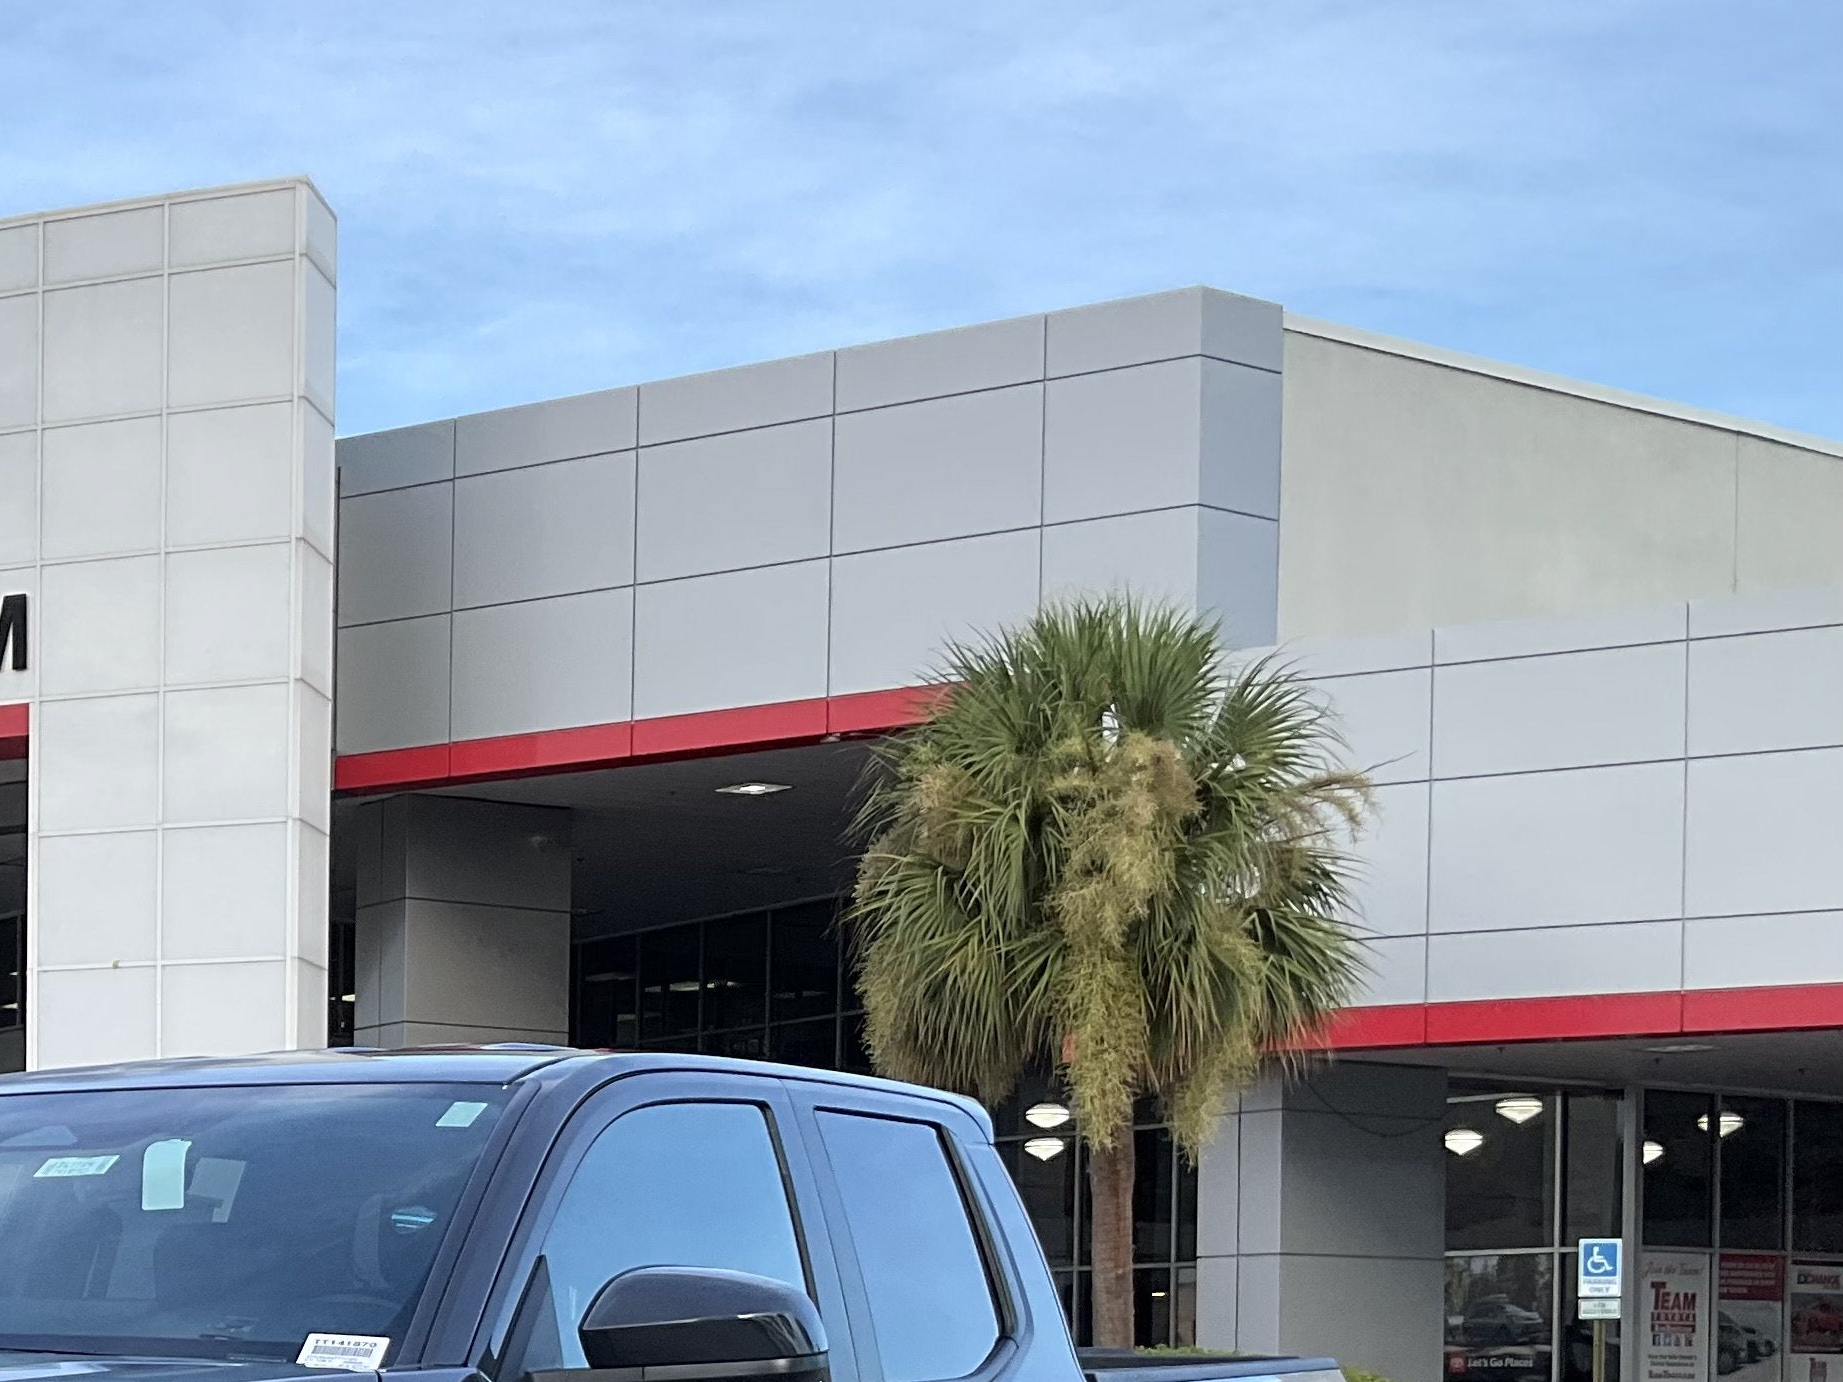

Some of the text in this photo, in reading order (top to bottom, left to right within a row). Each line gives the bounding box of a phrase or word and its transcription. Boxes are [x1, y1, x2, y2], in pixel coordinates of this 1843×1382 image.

[1468, 1357, 1533, 1368] Let's Go Places
